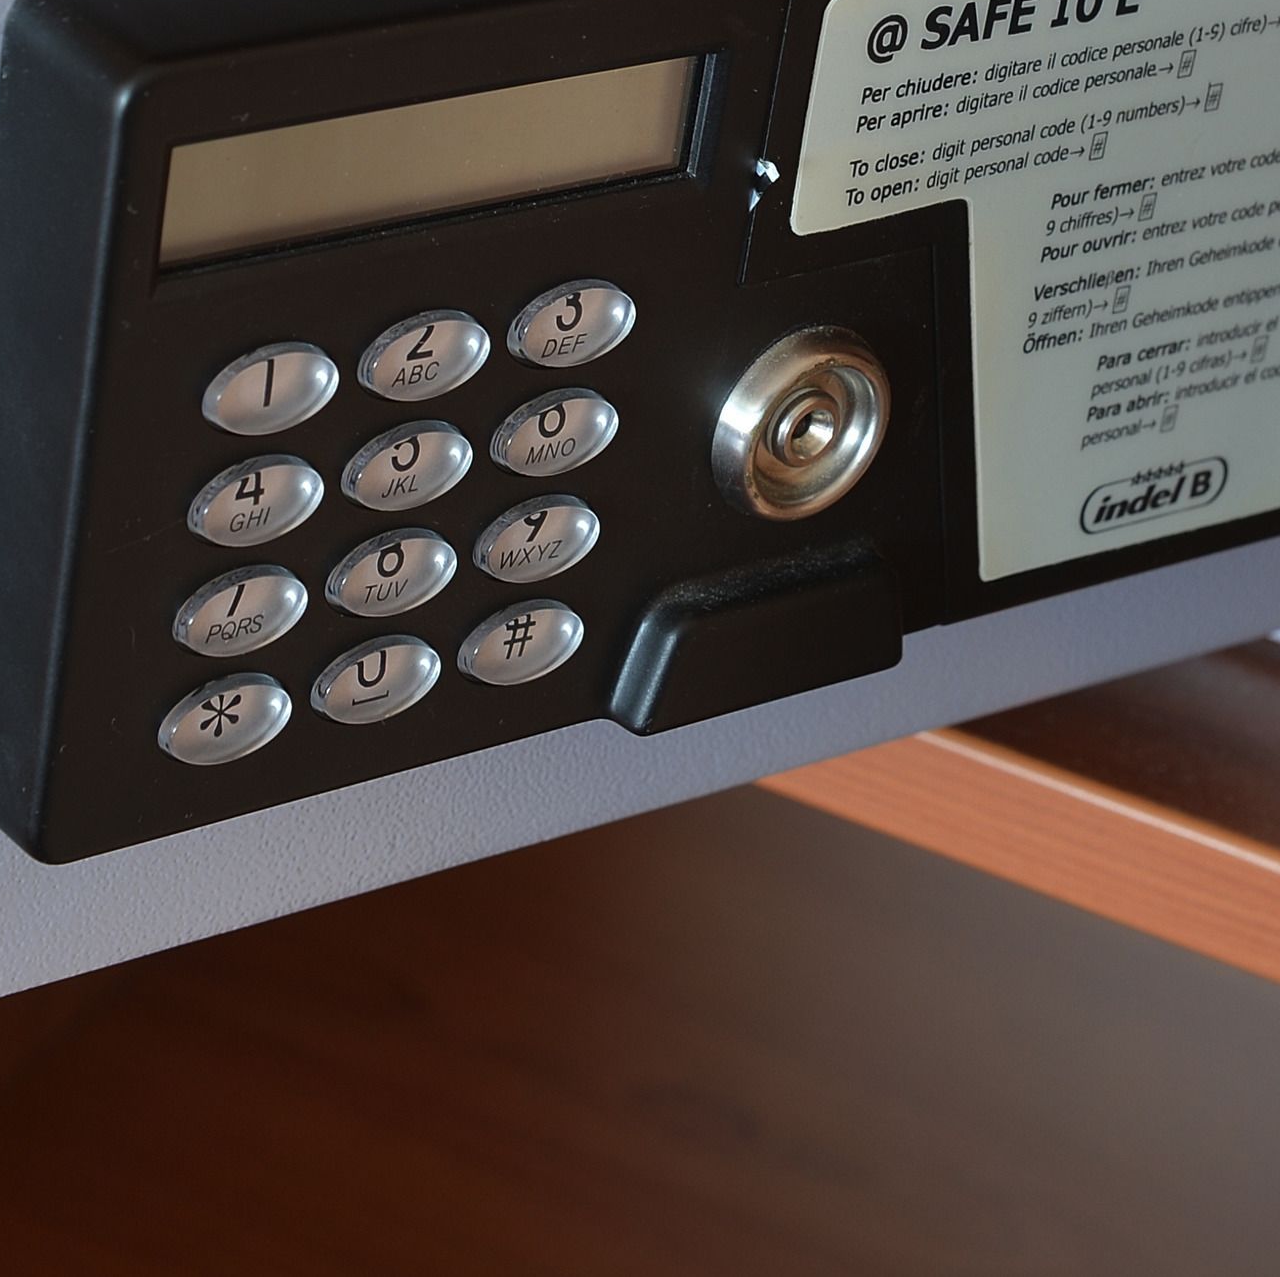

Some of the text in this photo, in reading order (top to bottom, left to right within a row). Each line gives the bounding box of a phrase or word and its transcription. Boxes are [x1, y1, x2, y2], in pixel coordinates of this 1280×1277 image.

[866, 14, 908, 64] @
[861, 85, 891, 105] Per
[895, 70, 978, 98] chiudere:
[984, 57, 1042, 83] digitare
[1047, 53, 1057, 70] il
[1061, 45, 1108, 67] codice
[1112, 31, 1184, 61] personale
[856, 113, 886, 133] Per
[890, 102, 949, 129] aprire:
[956, 90, 1014, 115] digitare
[1018, 84, 1028, 102] il
[1032, 76, 1080, 99] codice
[1084, 62, 1158, 93] personale
[850, 160, 869, 178] To
[874, 149, 926, 173] close:
[932, 140, 966, 164] digit
[970, 124, 1036, 157] personal
[1039, 118, 1076, 139] code
[1080, 110, 1113, 134] (1-9
[1115, 95, 1186, 123] numbers)
[846, 188, 865, 206] To
[869, 178, 921, 203] open:
[926, 168, 959, 191] digit
[964, 153, 1029, 184] personal
[1033, 145, 1070, 167] code
[1051, 190, 1090, 210] Pour
[1093, 176, 1156, 202] fermer:
[1161, 166, 1207, 188] entrez
[1210, 157, 1247, 177] votre
[1040, 243, 1079, 263] Pour
[1082, 230, 1137, 255] ouvrir:
[1142, 219, 1188, 241] entrez
[1191, 211, 1228, 230] votre
[1231, 201, 1265, 222] code
[1046, 219, 1056, 237] 9
[1059, 206, 1119, 234] chiffres)
[1146, 255, 1185, 277] Ihren
[1188, 235, 1275, 268] Geheimkode
[554, 291, 584, 332] 3
[1022, 328, 1084, 354] Öffnen:
[1089, 317, 1128, 339] Ihren
[1132, 297, 1219, 329] Geheimkode
[1027, 311, 1038, 329] 9
[406, 324, 435, 361] 2
[540, 334, 587, 359] DEF
[1096, 352, 1132, 371] Para
[1137, 337, 1192, 362] cerrar:
[1196, 320, 1263, 347] introducir
[262, 358, 276, 408] 1
[390, 362, 440, 387] ABC
[1090, 369, 1153, 400] personal
[1086, 403, 1121, 423] Para
[1125, 391, 1170, 414] abrir:
[1174, 370, 1241, 401] introducir
[524, 439, 577, 466] MNO
[1080, 419, 1143, 451] personal
[234, 470, 265, 506] 4
[381, 475, 419, 499] JKL
[1092, 470, 1212, 525] indel B
[228, 508, 271, 533] GHI
[522, 510, 549, 544] 9
[499, 540, 563, 570] WXYZ
[363, 580, 409, 604] TUV
[205, 615, 264, 643] PQRS
